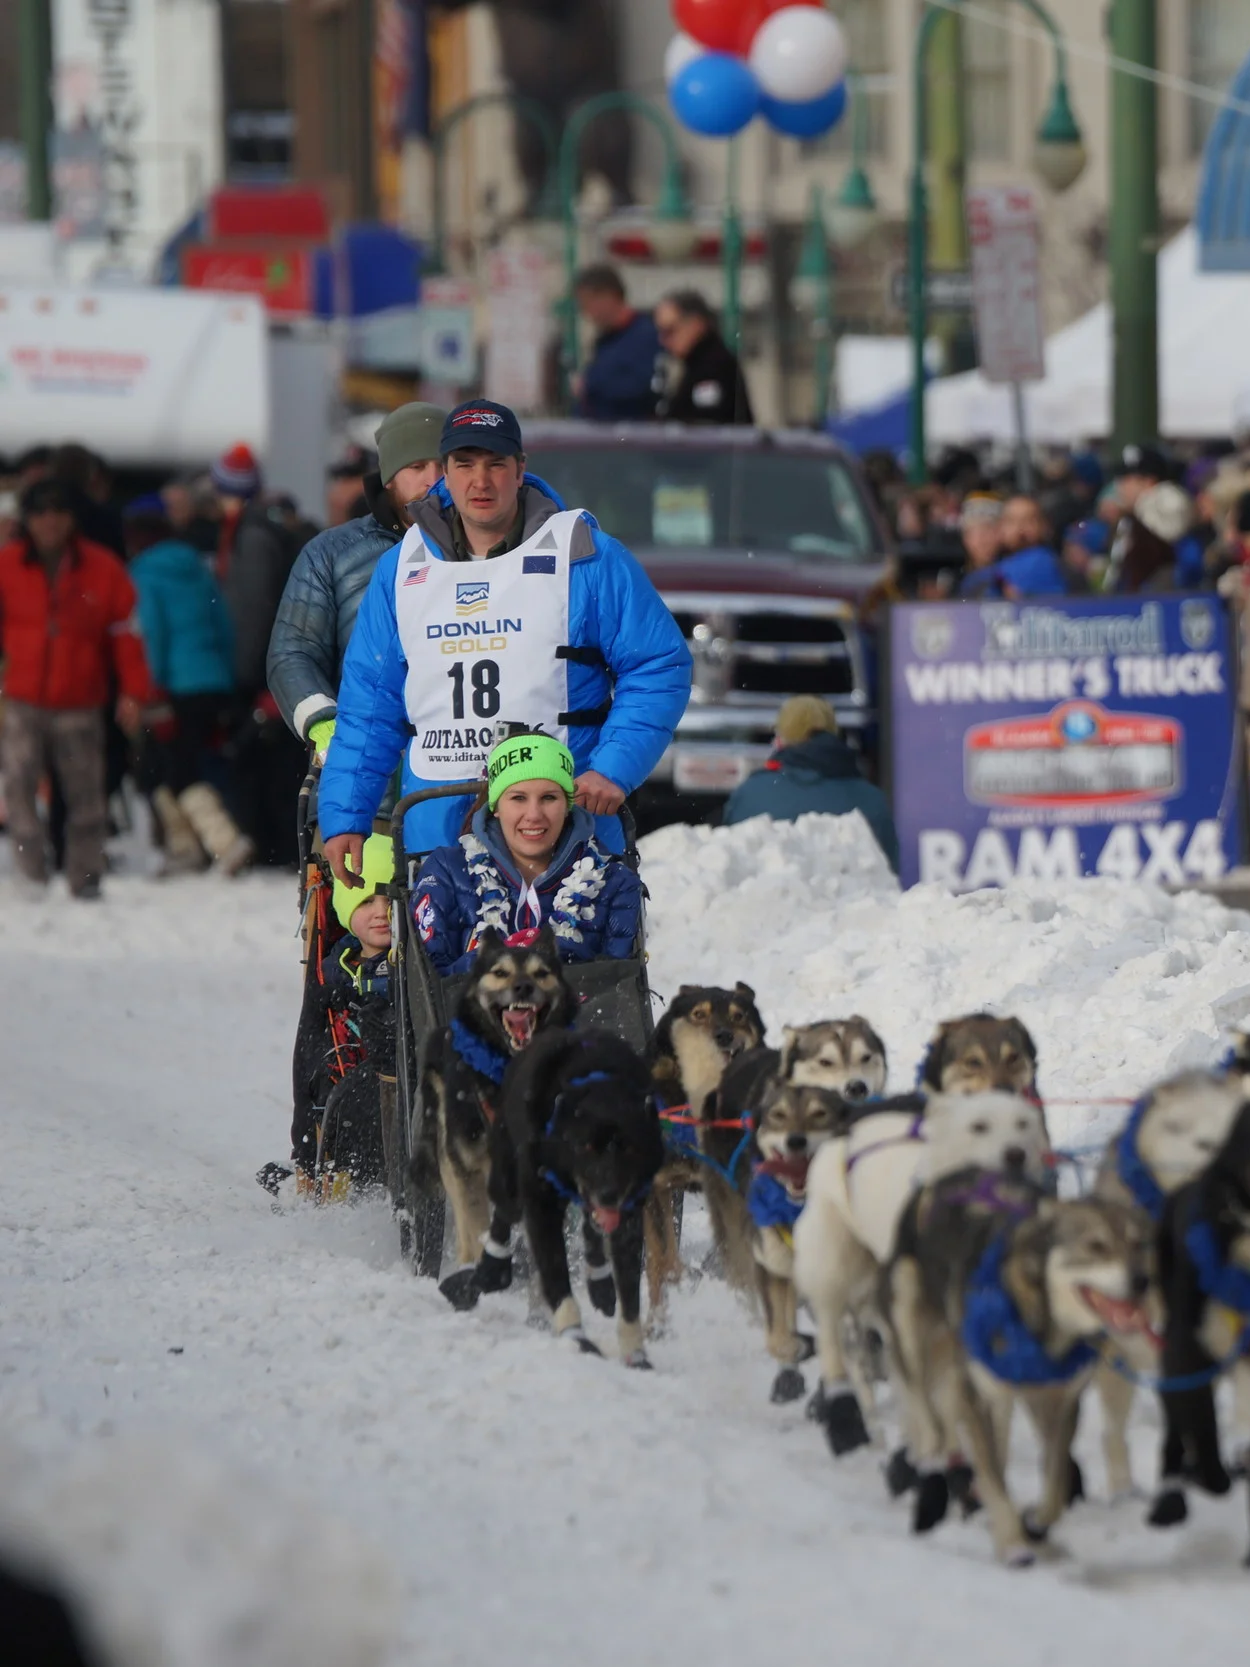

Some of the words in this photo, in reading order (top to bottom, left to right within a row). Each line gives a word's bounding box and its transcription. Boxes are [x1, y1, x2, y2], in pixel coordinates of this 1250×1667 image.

[426, 618, 522, 639] DONLIN
[440, 637, 507, 655] GOLD
[447, 659, 500, 719] 18
[905, 661, 1112, 704] WINNER'S
[1114, 652, 1224, 698] TRUCK
[422, 727, 495, 749] IDITARO
[918, 828, 1082, 893] RAM
[1096, 820, 1229, 885] 4X4
